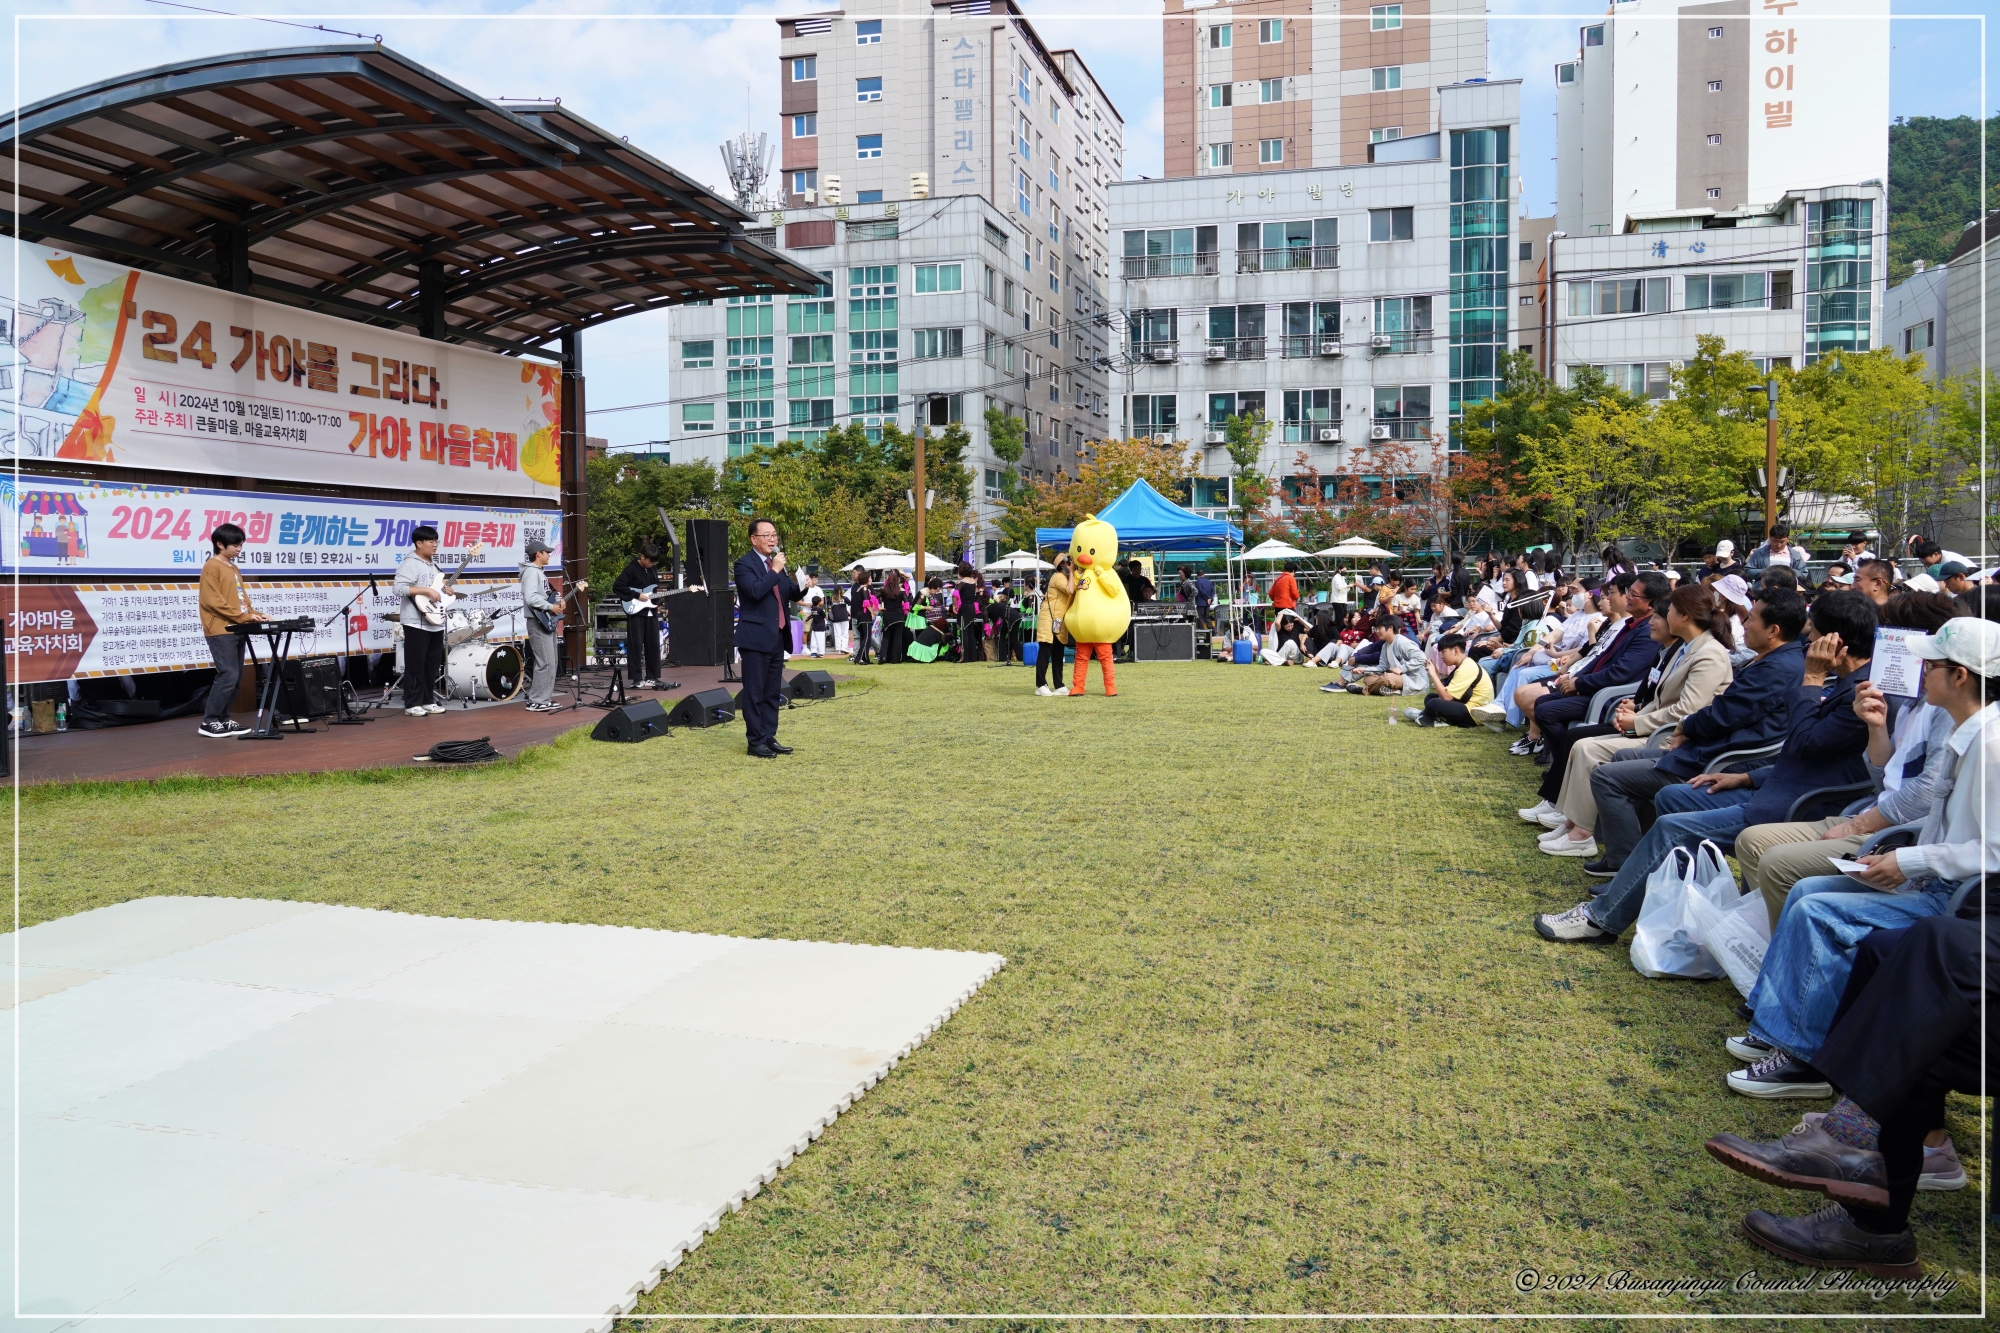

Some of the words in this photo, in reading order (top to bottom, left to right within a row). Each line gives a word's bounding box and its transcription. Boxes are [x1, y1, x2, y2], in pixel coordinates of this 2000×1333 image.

[951, 36, 976, 184] 스타팰리스
[1226, 187, 1275, 206] 가야
[1307, 181, 1353, 201] 빌딩
[229, 325, 340, 394] 가야를
[350, 351, 448, 410] 그리다.
[179, 393, 219, 414] 2024년
[222, 400, 246, 417] 10월
[248, 403, 284, 422] 12일(토)
[286, 408, 342, 429] 11:00~17:00
[195, 415, 242, 437] 큰돌마을,
[245, 422, 307, 444] 마을교육자치회
[348, 411, 412, 462] 가야
[419, 421, 518, 472] 마을축제
[107, 505, 192, 541] 2024
[278, 511, 369, 547] 함께하는
[443, 521, 516, 548] 마을축제
[172, 549, 196, 563] 일시
[250, 551, 272, 564] 10월
[276, 552, 296, 564] 12일
[299, 552, 317, 565] (토)
[320, 553, 353, 564] 오후2시
[365, 553, 379, 565] 5시
[8, 609, 76, 631] 가야마을
[4, 632, 83, 656] 교육자치회
